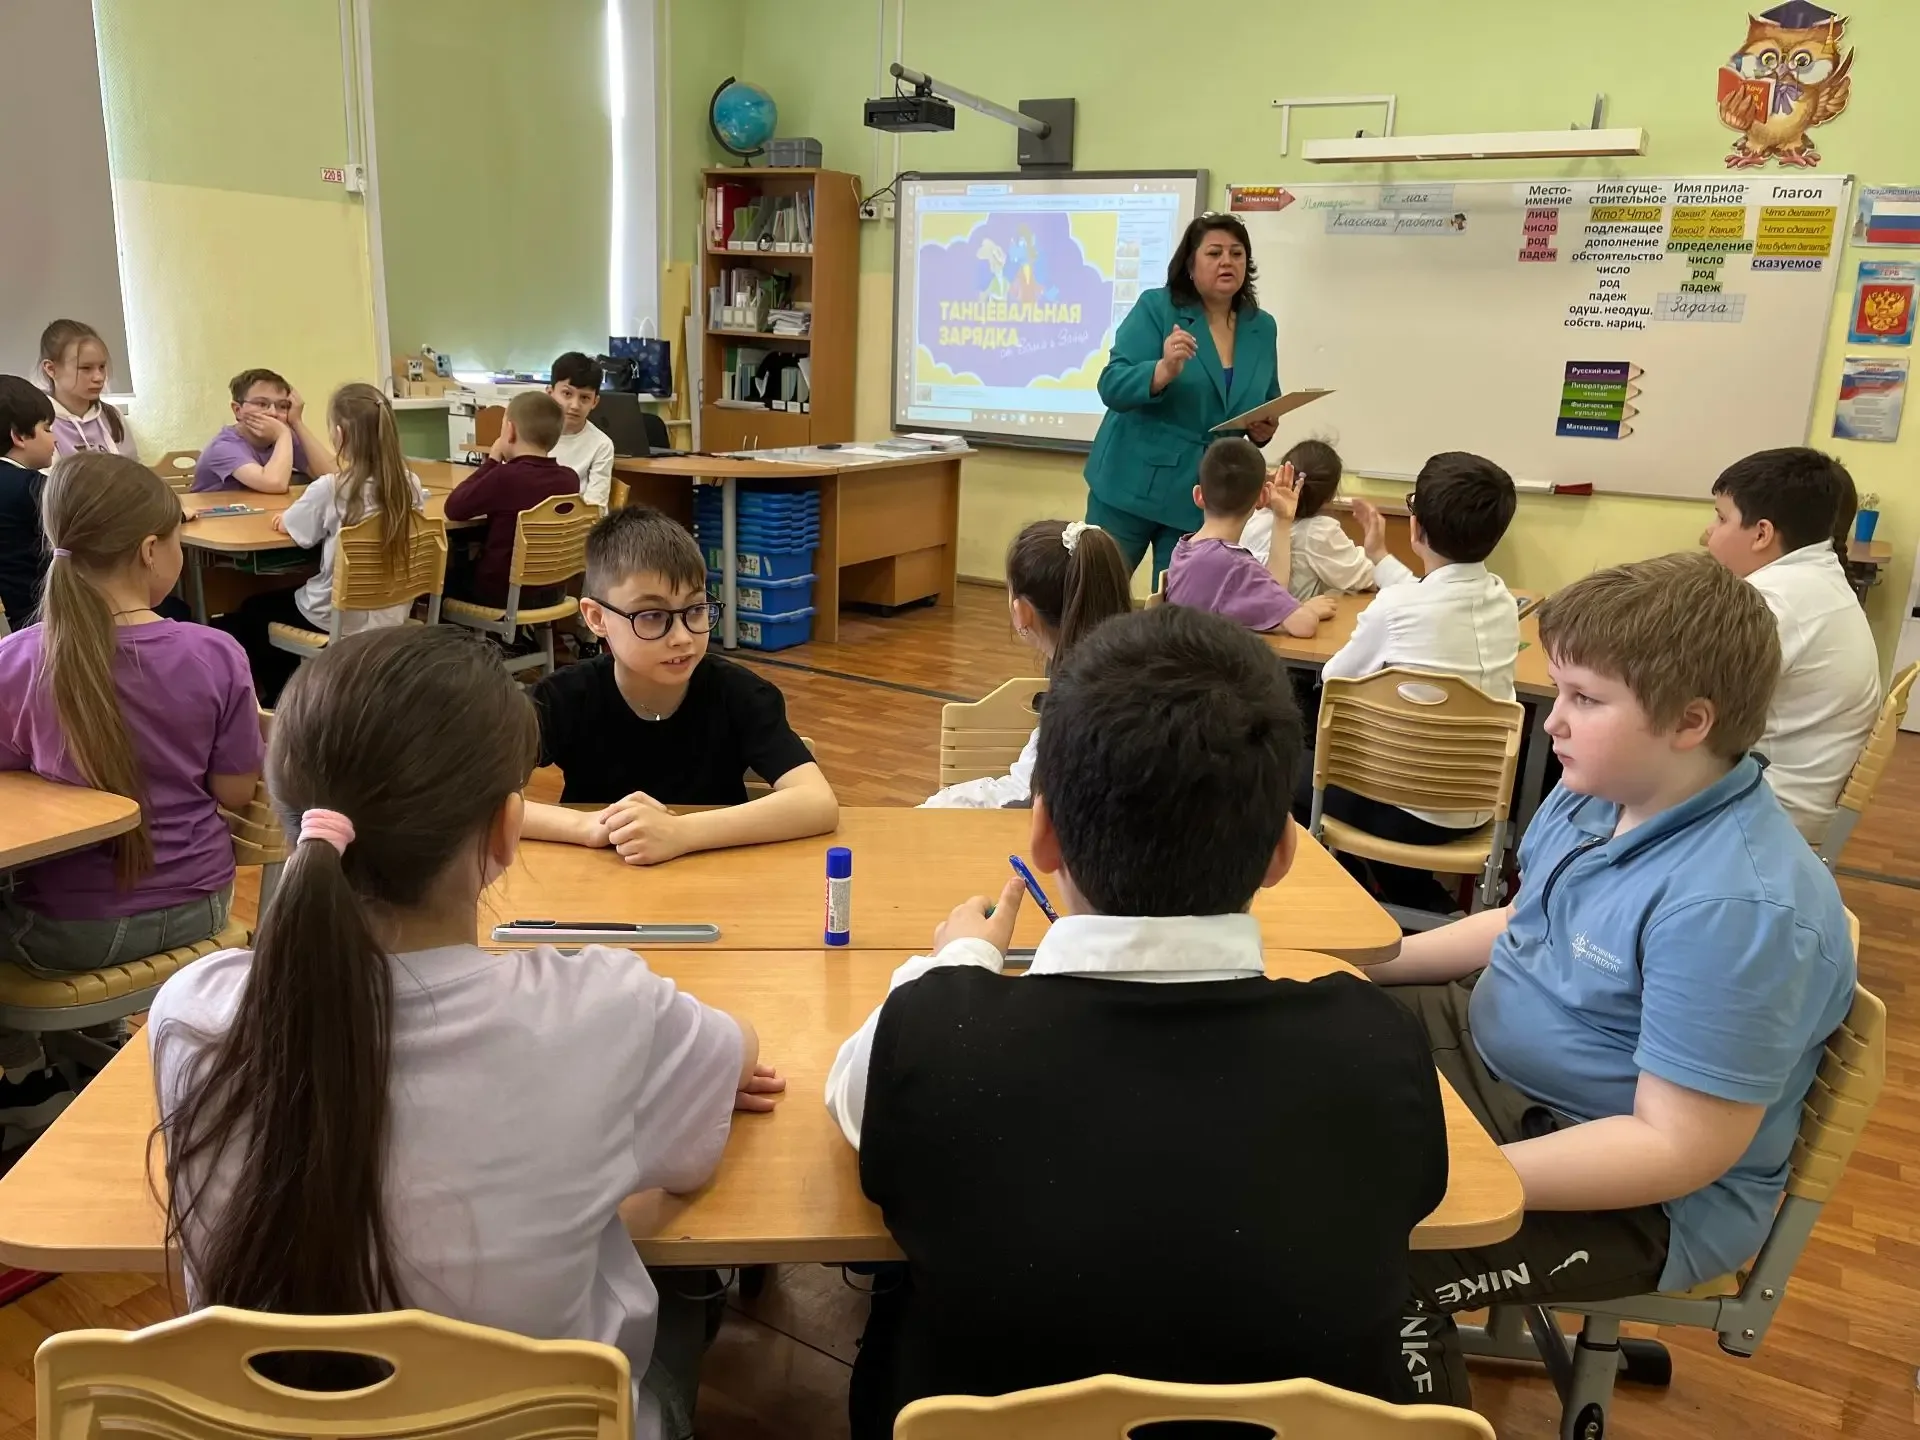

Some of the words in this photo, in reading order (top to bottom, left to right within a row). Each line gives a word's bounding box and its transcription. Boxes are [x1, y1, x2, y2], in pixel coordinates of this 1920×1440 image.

[1529, 185, 1572, 195] Место-
[1597, 184, 1624, 194] Имя
[1626, 185, 1662, 196] суще-
[1674, 183, 1703, 193] Имя
[1704, 184, 1750, 195] прила-
[1772, 186, 1823, 199] Глагол
[1525, 196, 1572, 205] имение
[1589, 195, 1666, 204] ствительное
[1676, 195, 1743, 204] гательное
[1527, 211, 1557, 220] лицо
[1592, 208, 1624, 219] Кто?
[1627, 208, 1661, 219] Что?
[1765, 208, 1785, 217] Что
[1333, 213, 1388, 228] Классная
[1394, 213, 1444, 233] работа
[1524, 224, 1557, 232] число
[1584, 225, 1663, 236] подлежащее
[1763, 226, 1785, 234] Что
[1527, 237, 1548, 247] род
[1585, 239, 1659, 249] дополнение
[1667, 241, 1753, 252] определение
[1519, 251, 1556, 261] падеж
[1572, 252, 1663, 261] обстоятельство
[1688, 256, 1724, 265] число
[1752, 258, 1822, 270] сказуемое
[1596, 265, 1630, 274] число
[1692, 270, 1715, 280] род
[1599, 278, 1620, 289] род
[1680, 283, 1721, 294] падеж
[1589, 292, 1627, 302] падеж
[1569, 304, 1602, 315] одуш.
[1604, 306, 1653, 316] неодуш.
[1671, 295, 1728, 319] Задача
[939, 301, 1082, 324] ТАНЦЕВАЛЬНАЯ
[1564, 317, 1604, 328] собств.
[1606, 320, 1646, 330] нариц.
[938, 326, 1019, 350] ЗАРЯДКА
[1572, 367, 1601, 375] Русский
[1571, 381, 1622, 390] Литературное
[1566, 423, 1608, 432] Математика
[1585, 951, 1620, 973] HORIZON
[1435, 1262, 1531, 1305] NIKE
